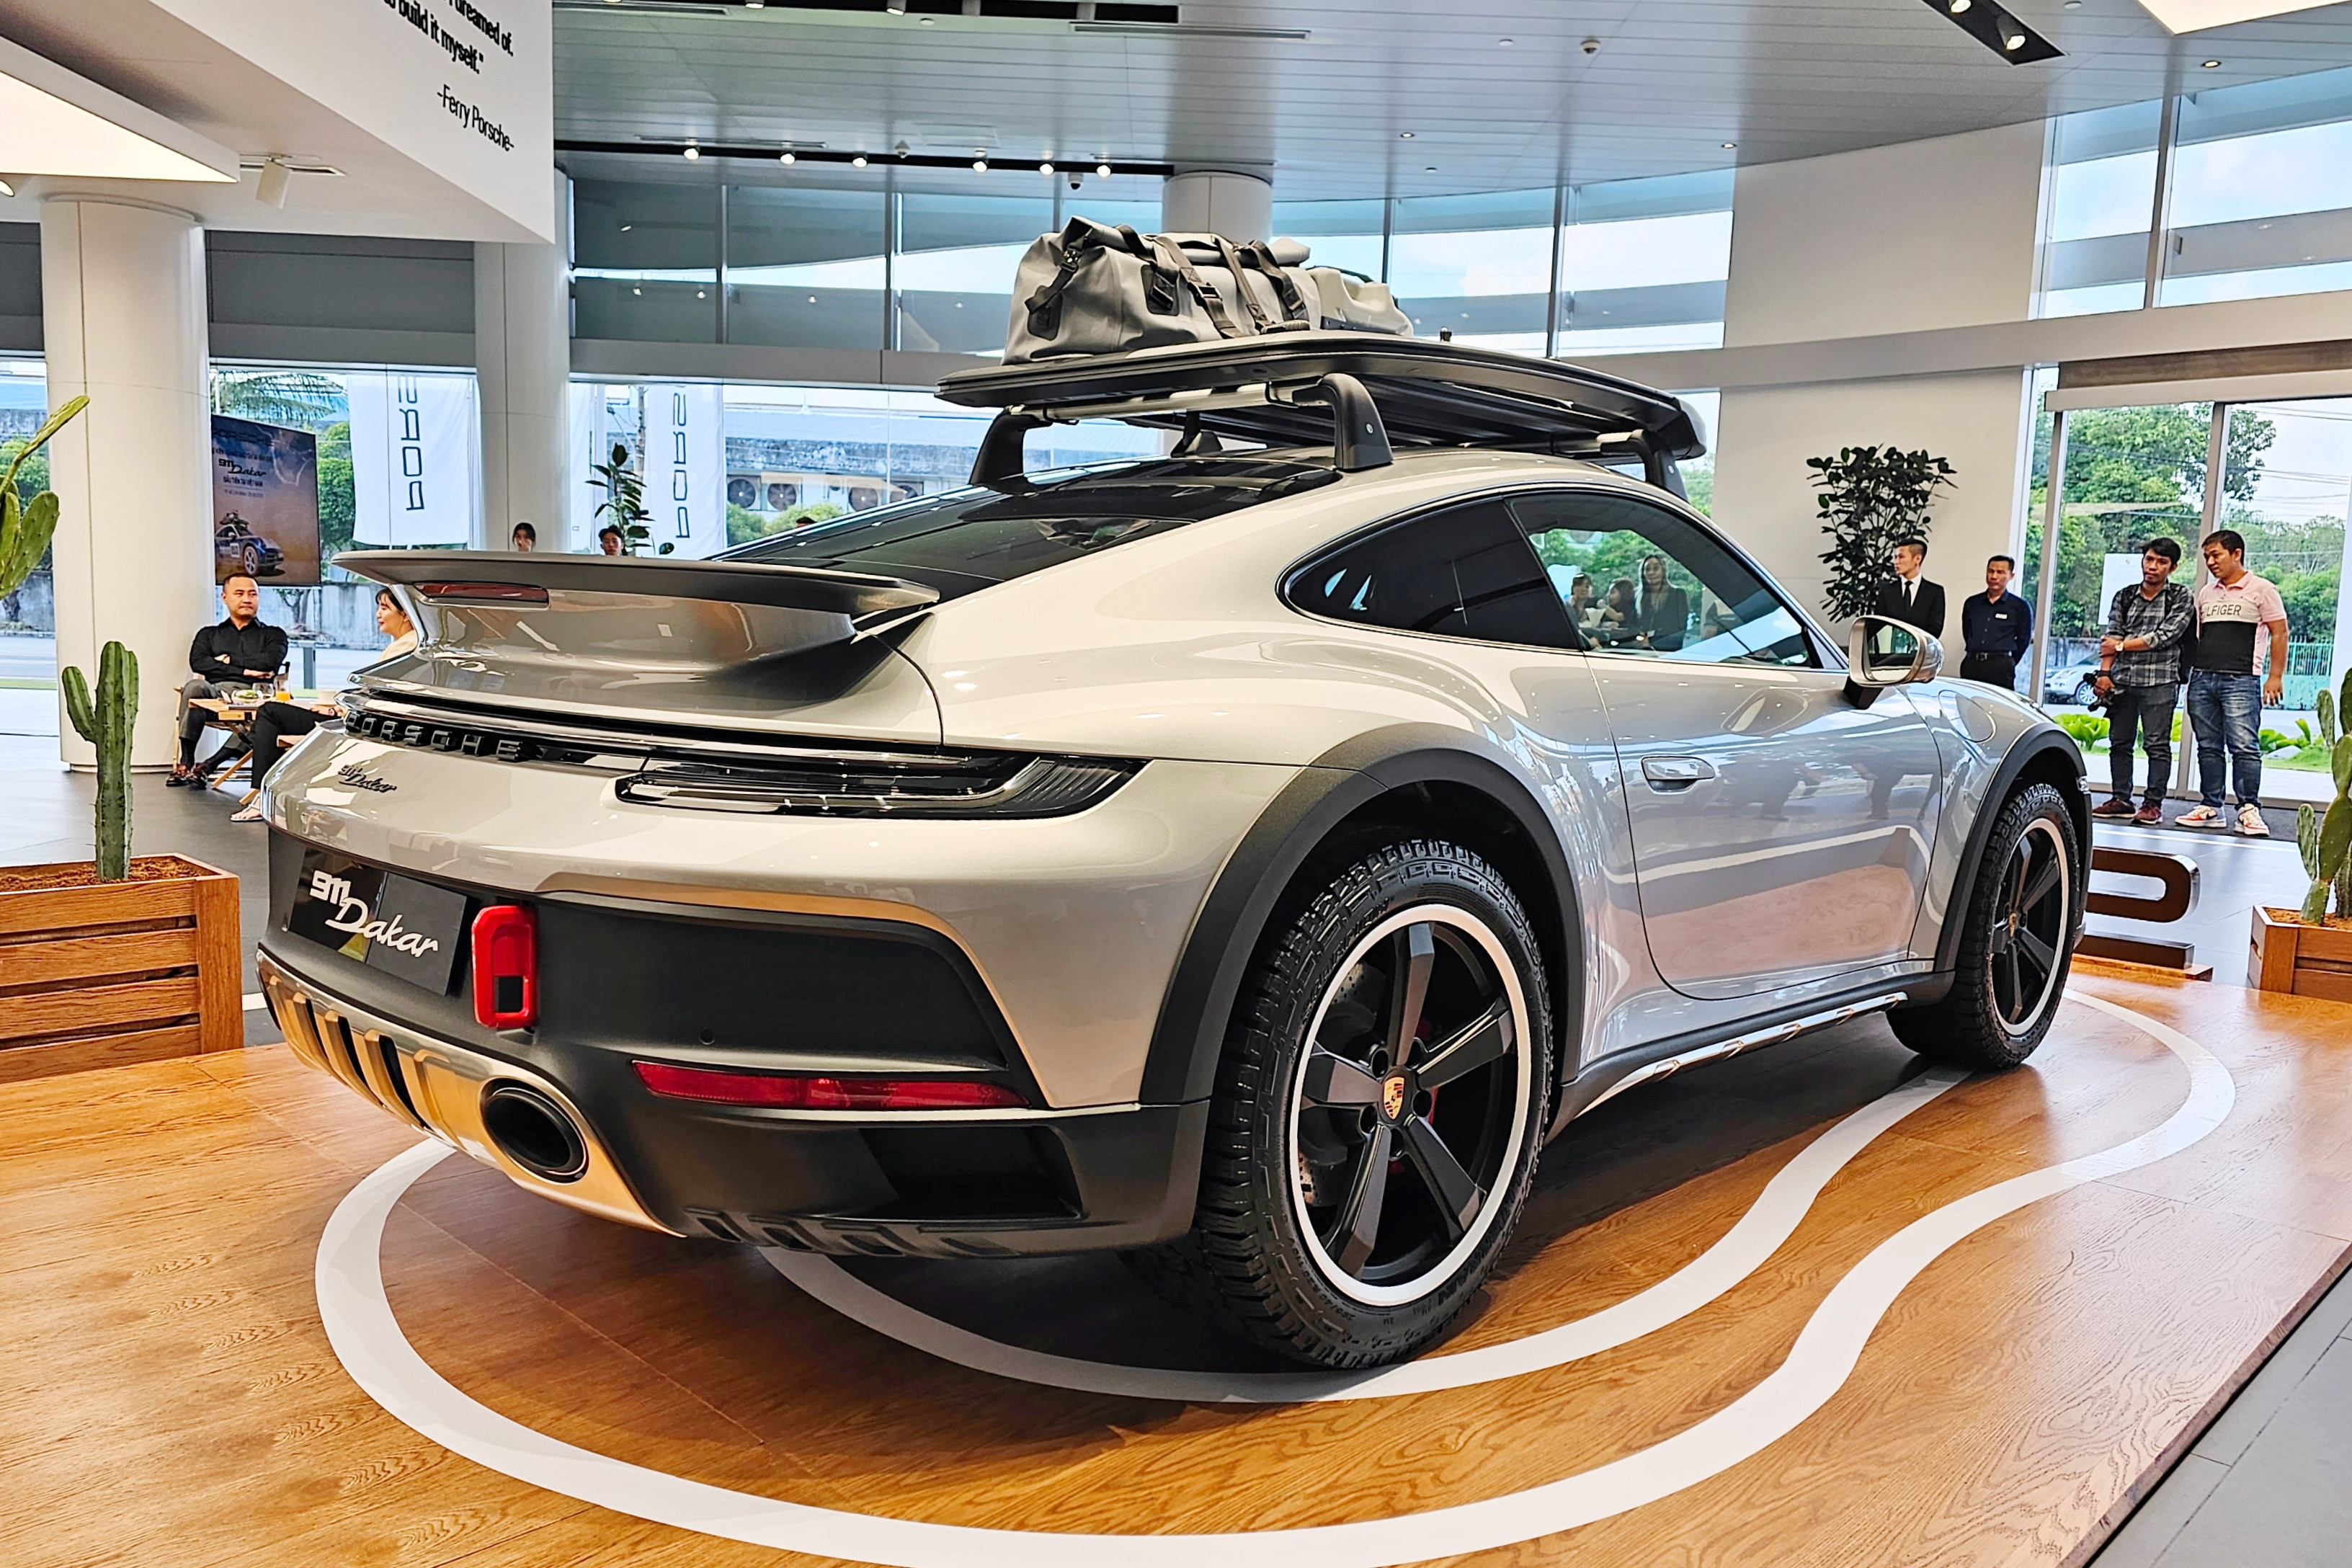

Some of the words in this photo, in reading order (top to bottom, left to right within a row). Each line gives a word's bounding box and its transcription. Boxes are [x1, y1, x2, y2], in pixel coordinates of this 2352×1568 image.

[398, 0, 428, 35] build
[430, 13, 440, 44] it
[227, 464, 267, 476] Dakar
[345, 710, 524, 762] PORSCHE
[338, 764, 362, 777] 911
[339, 772, 397, 793] Dakar
[309, 869, 352, 907] 911
[325, 896, 439, 958] Dakar
